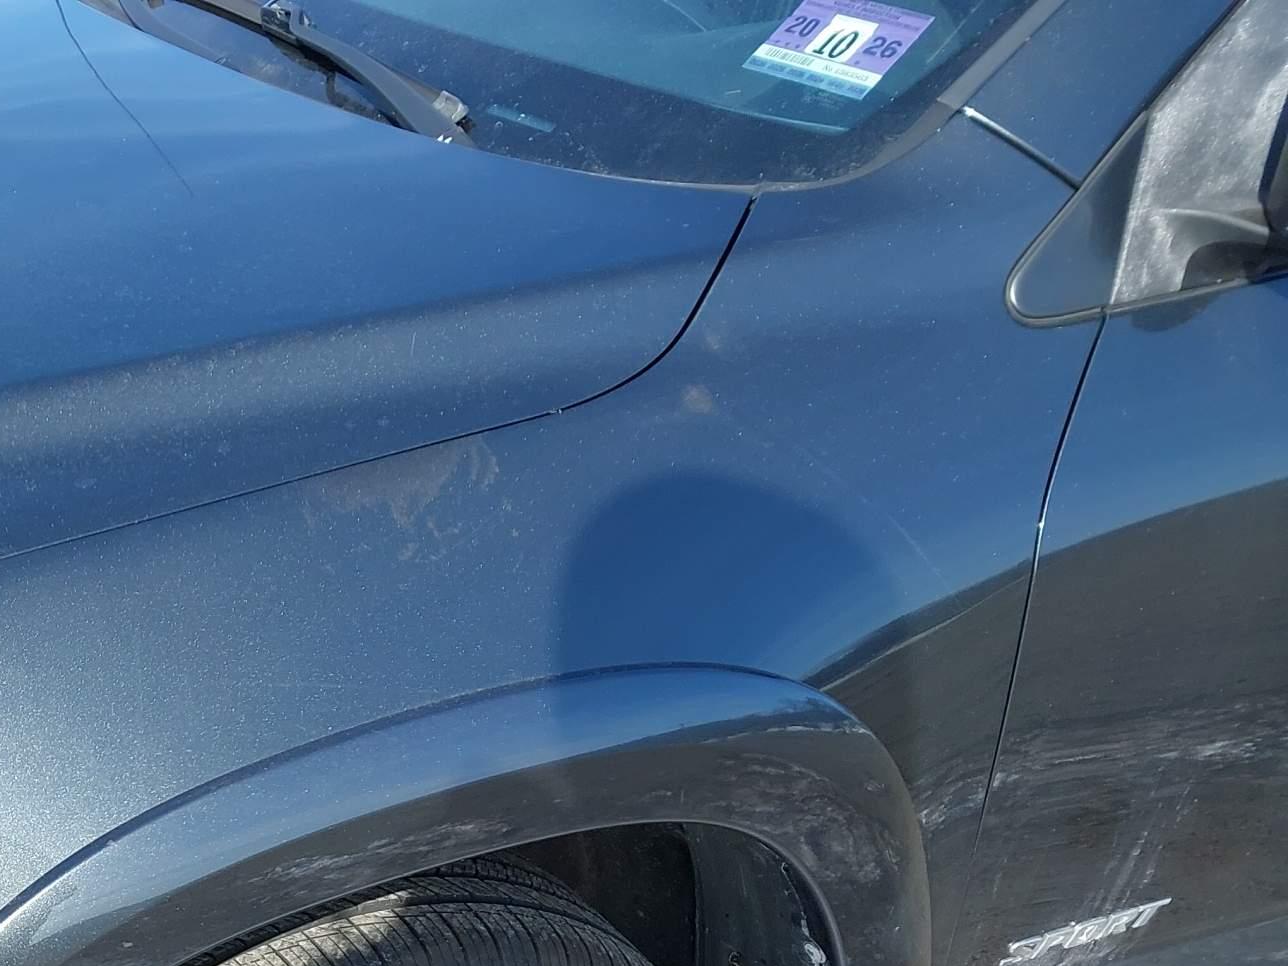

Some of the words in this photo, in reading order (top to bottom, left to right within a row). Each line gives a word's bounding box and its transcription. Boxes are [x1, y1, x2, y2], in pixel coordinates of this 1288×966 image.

[784, 15, 820, 38] 20
[812, 28, 859, 59] 10
[863, 36, 904, 59] 26
[999, 897, 1173, 966] SPORT
